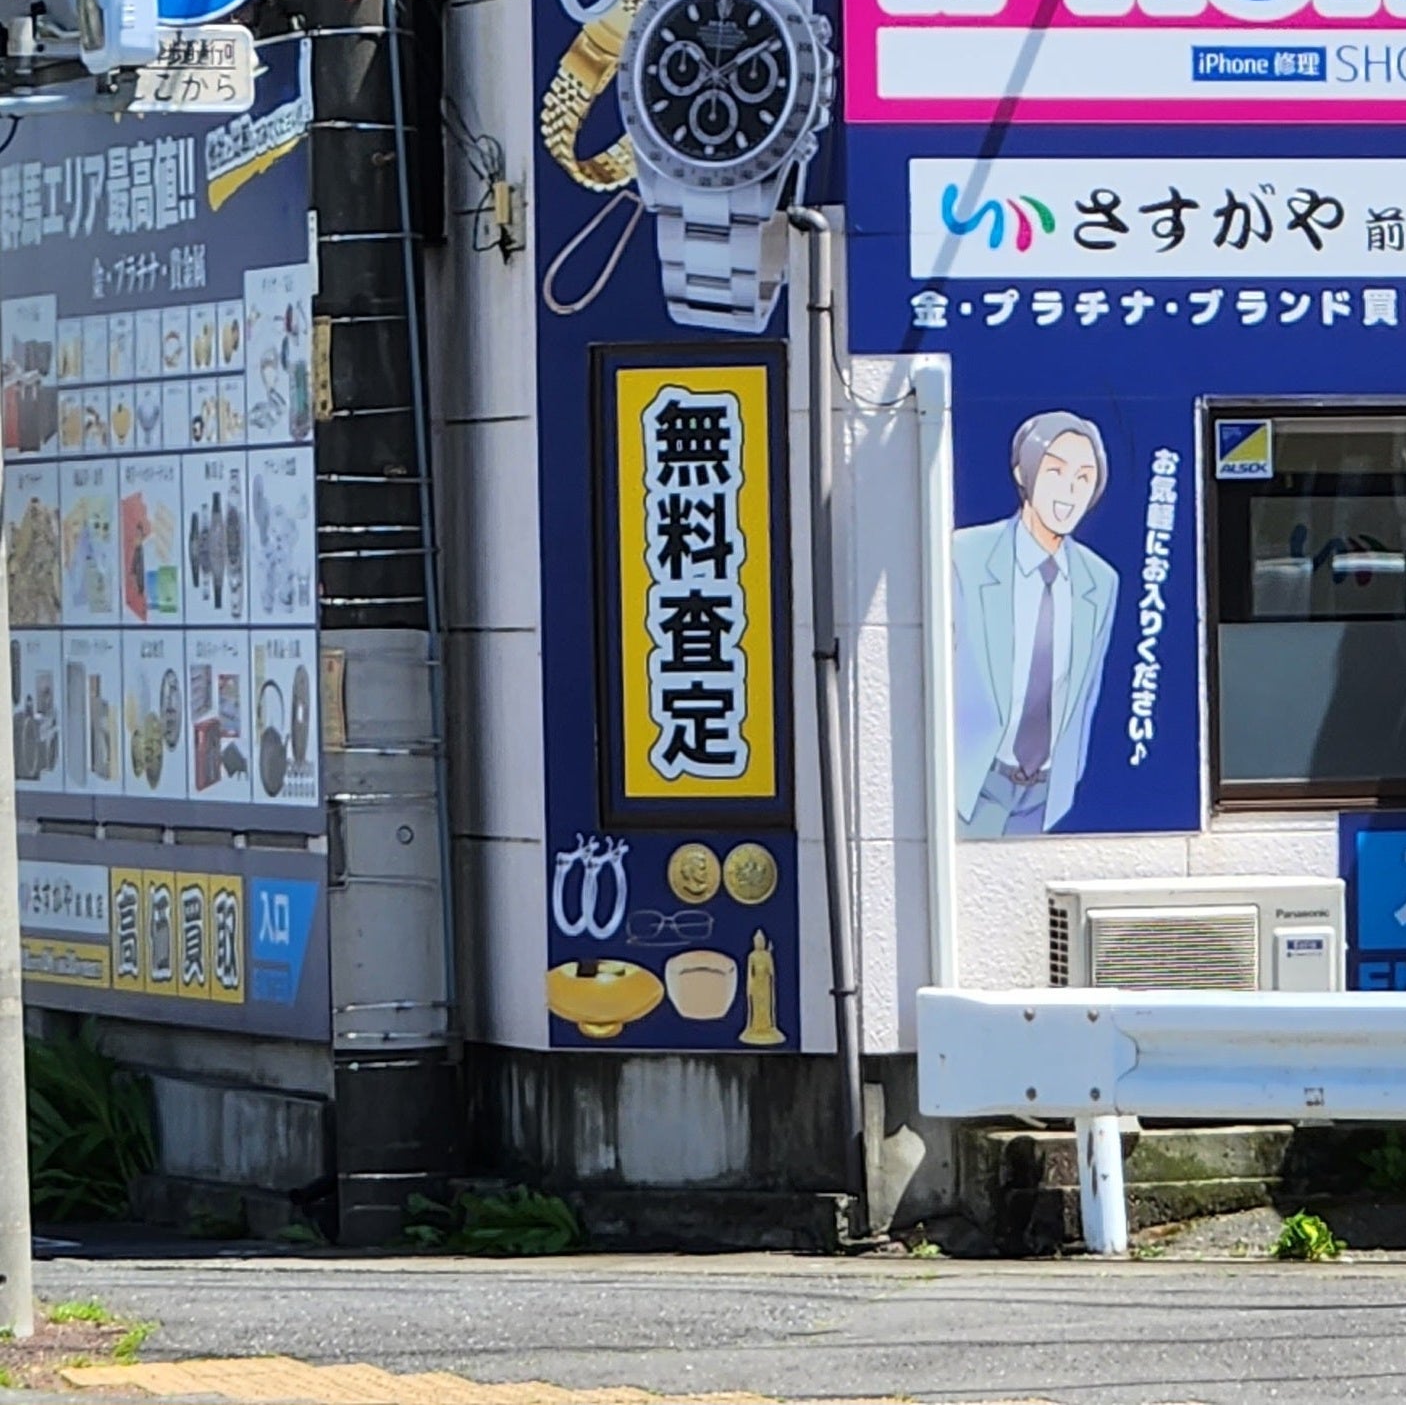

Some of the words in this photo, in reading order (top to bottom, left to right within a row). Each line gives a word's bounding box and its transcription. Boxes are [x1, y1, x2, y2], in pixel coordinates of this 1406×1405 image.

[137, 73, 236, 102] こから
[1199, 51, 1269, 76] iPhone
[1274, 51, 1320, 77] 修理
[1074, 184, 1344, 253] さすがや
[652, 395, 742, 772] 無料査定
[259, 890, 289, 945] 入口
